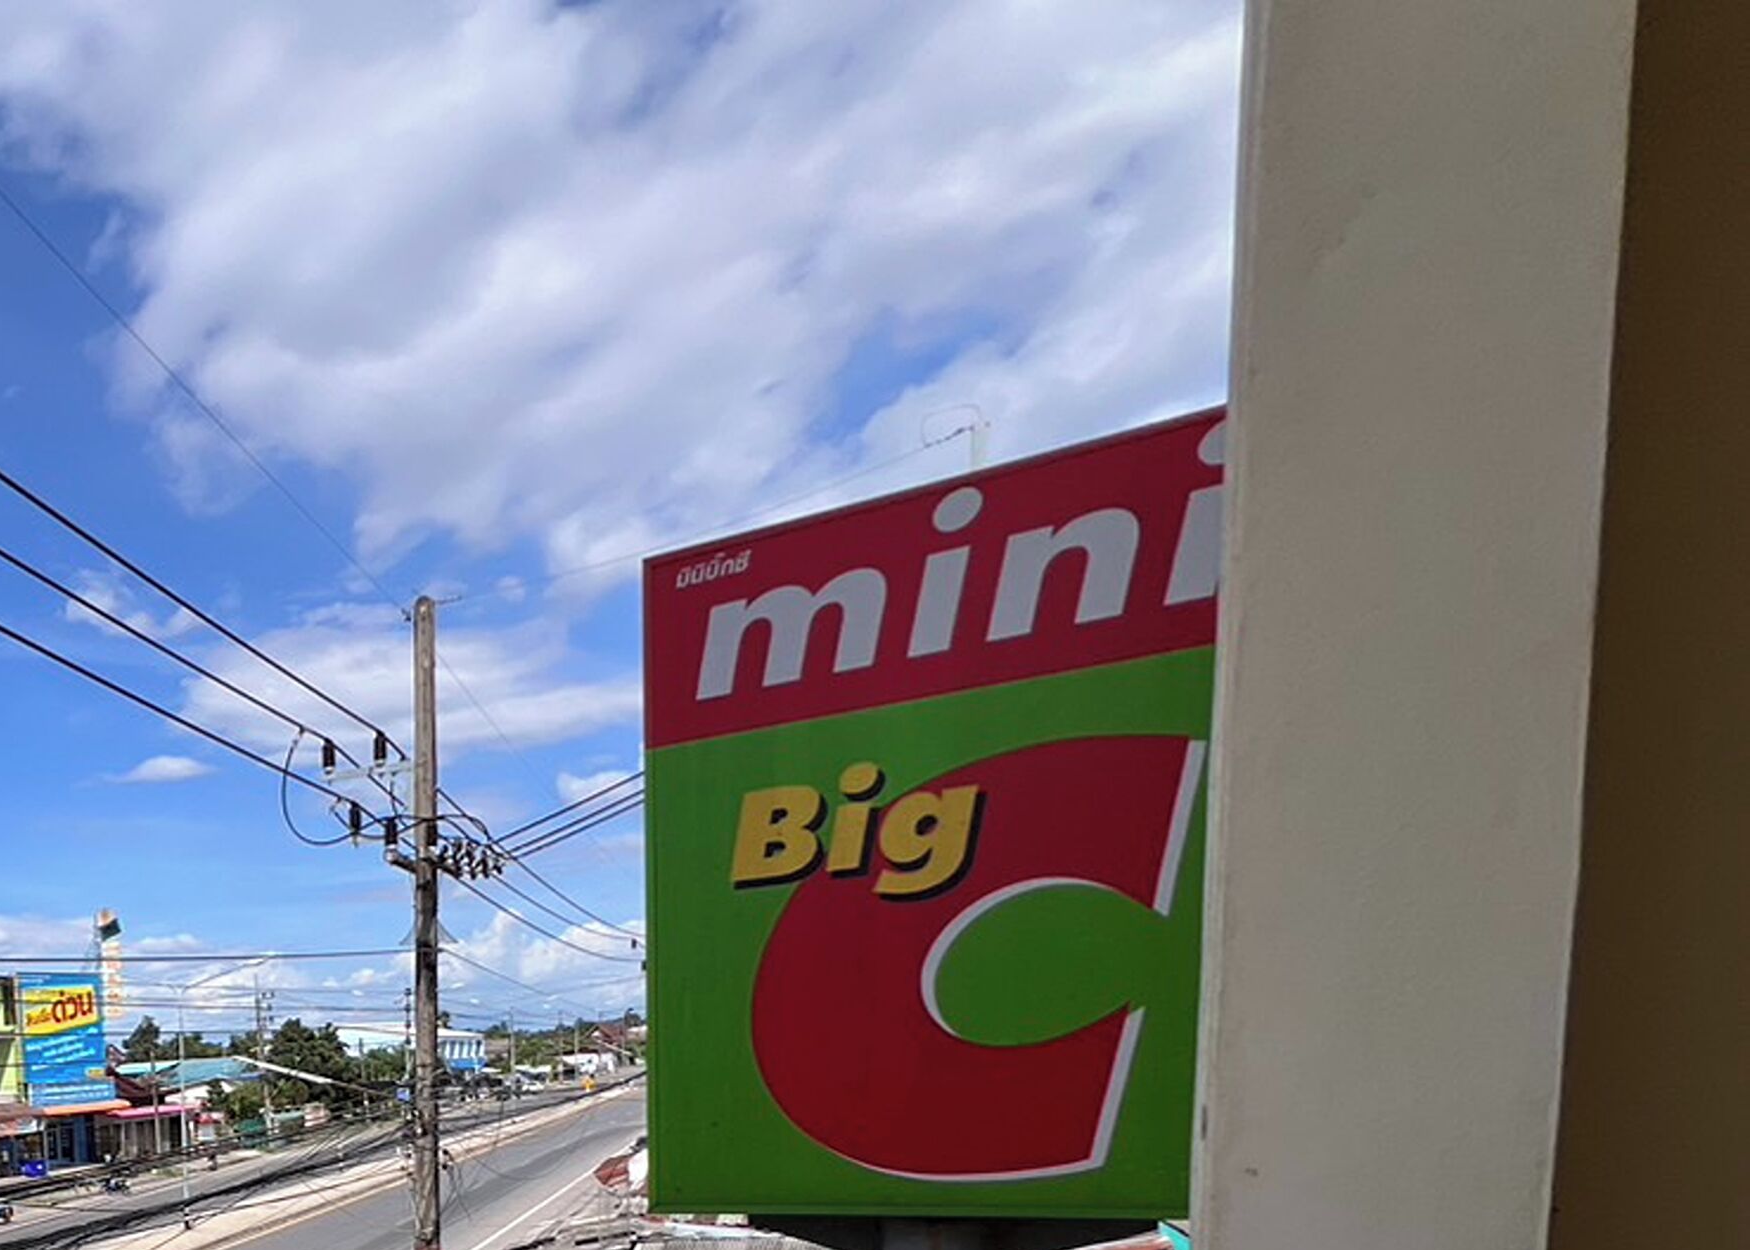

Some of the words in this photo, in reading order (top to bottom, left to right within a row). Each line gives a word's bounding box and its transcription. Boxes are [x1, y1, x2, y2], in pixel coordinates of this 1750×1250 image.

[695, 418, 1224, 702] mini
[729, 761, 984, 901] Big
[751, 733, 1207, 1182] C
